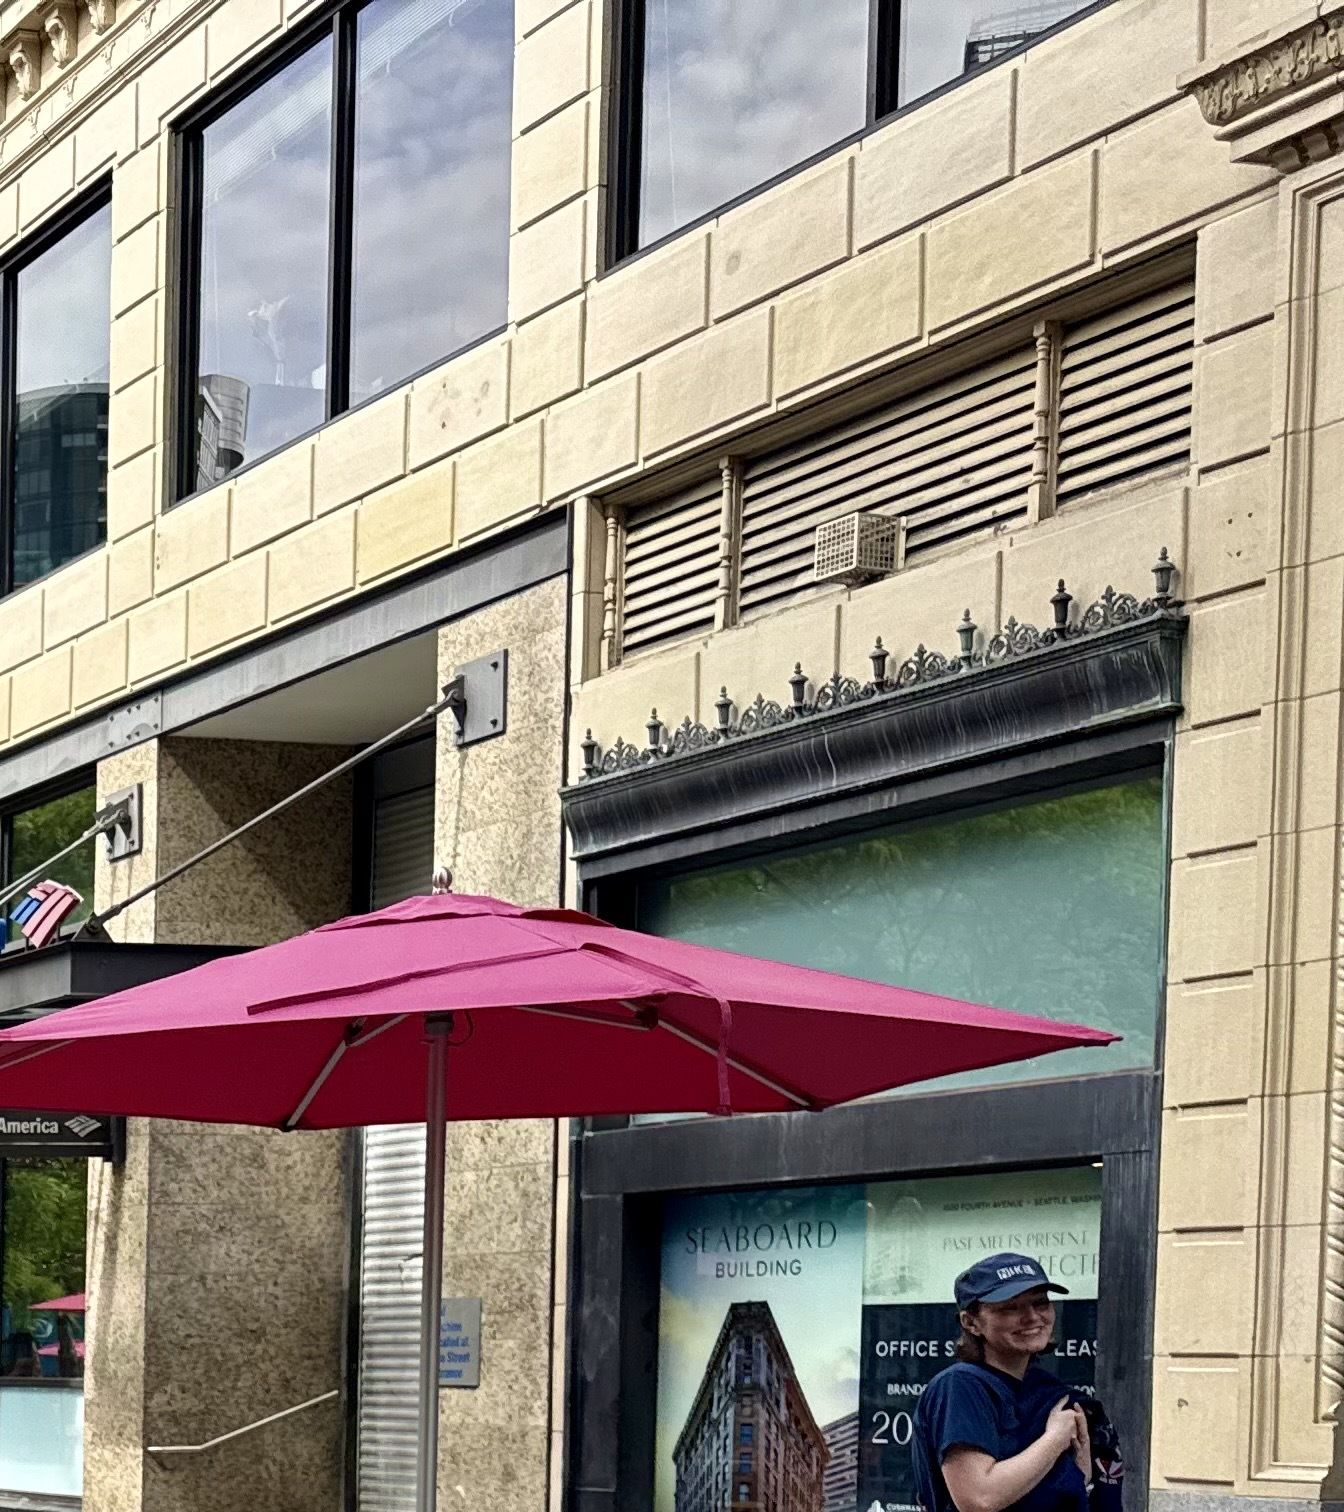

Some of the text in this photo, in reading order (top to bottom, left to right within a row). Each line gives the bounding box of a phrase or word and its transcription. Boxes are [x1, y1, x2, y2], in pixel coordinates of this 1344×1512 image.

[686, 1220, 837, 1254] SEABOARD
[943, 1230, 1088, 1250] PAST MEETS PRESENT
[715, 1258, 802, 1278] BUILDING
[875, 1340, 939, 1357] OFFICE
[872, 1410, 913, 1446] 20
